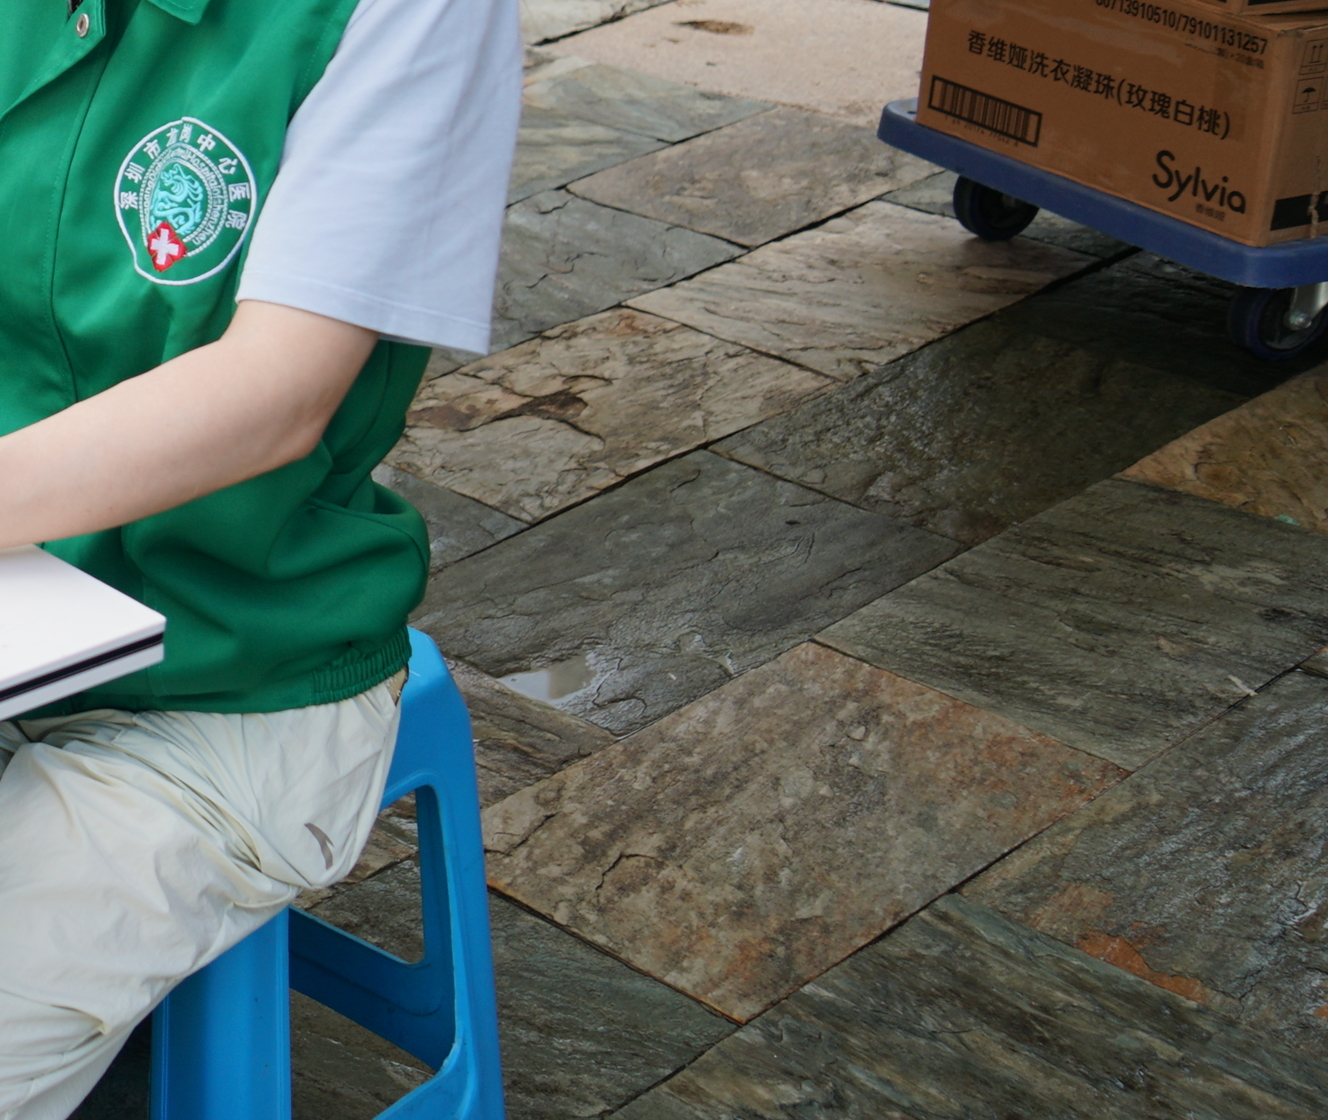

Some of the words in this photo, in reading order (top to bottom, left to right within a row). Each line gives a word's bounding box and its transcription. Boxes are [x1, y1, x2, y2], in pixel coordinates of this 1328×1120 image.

[968, 30, 1230, 140] 香维娅洗衣凝珠(玫瑰白桃)
[1152, 150, 1246, 214] Sylvia
